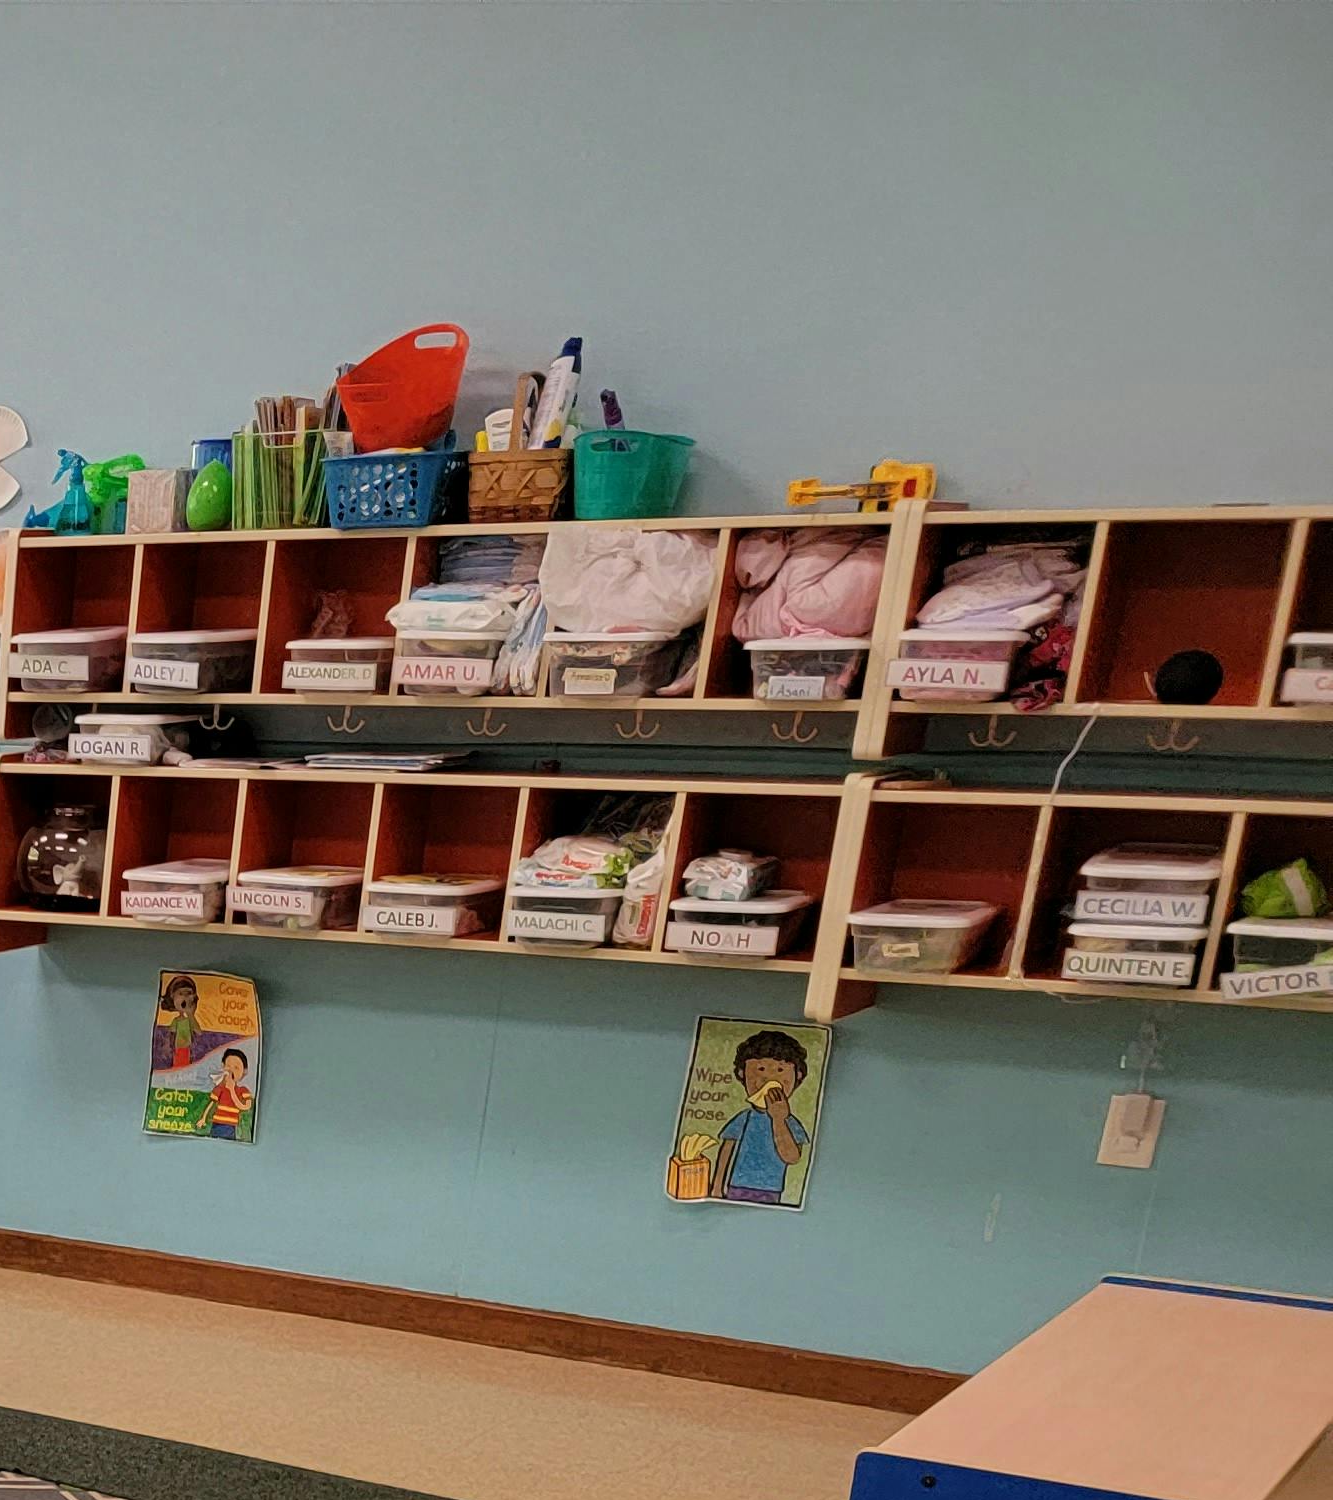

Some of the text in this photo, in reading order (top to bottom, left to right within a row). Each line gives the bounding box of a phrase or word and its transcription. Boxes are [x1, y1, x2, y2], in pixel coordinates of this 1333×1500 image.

[21, 659, 71, 675] ADA C.
[133, 663, 189, 683] ADLEY J.
[401, 663, 481, 682] AMAR U.
[901, 666, 985, 686] AYLA N.
[73, 739, 145, 756] LOGAN R.
[125, 896, 200, 911] KAIDANCE W.
[232, 891, 306, 910] LINCOLN S.
[1082, 897, 1198, 919] CECILIA W.
[376, 910, 439, 929] CALEB J.
[513, 915, 578, 932] MALACHI
[690, 929, 751, 949] NOAH
[1066, 955, 1190, 979] QUINTEN E.
[218, 982, 250, 998] Cover
[1229, 971, 1321, 995] VICTOR
[222, 1000, 248, 1012] your
[217, 1014, 254, 1031] cough
[695, 1067, 733, 1086] Wipe
[154, 1088, 194, 1103] Catch
[689, 1090, 730, 1105] your
[157, 1105, 189, 1118] your
